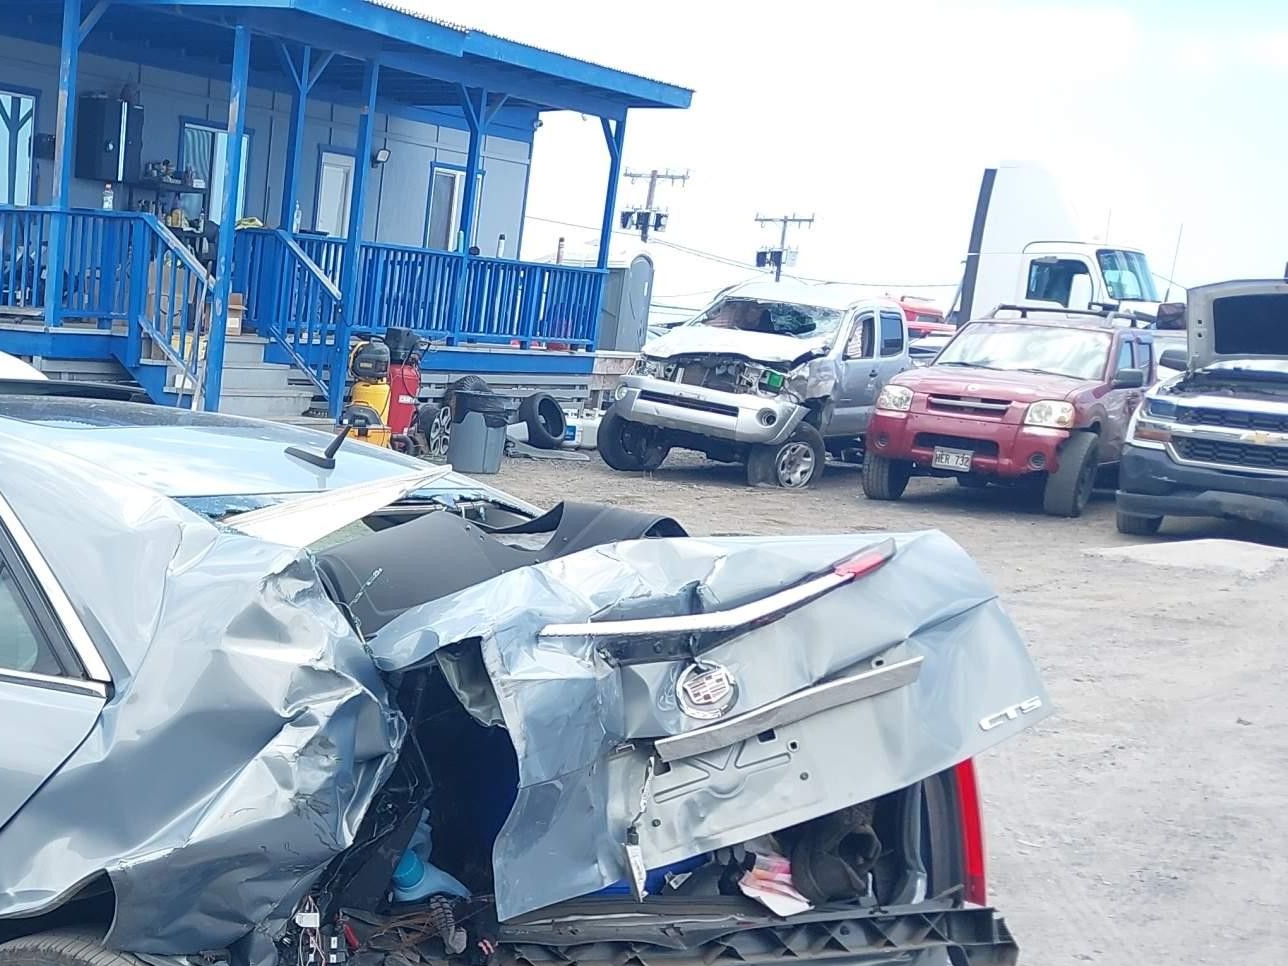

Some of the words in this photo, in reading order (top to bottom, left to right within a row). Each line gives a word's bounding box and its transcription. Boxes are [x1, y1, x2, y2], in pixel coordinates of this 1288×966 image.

[935, 453, 951, 465] HER
[955, 455, 970, 467] 732
[978, 695, 1043, 732] CTS
